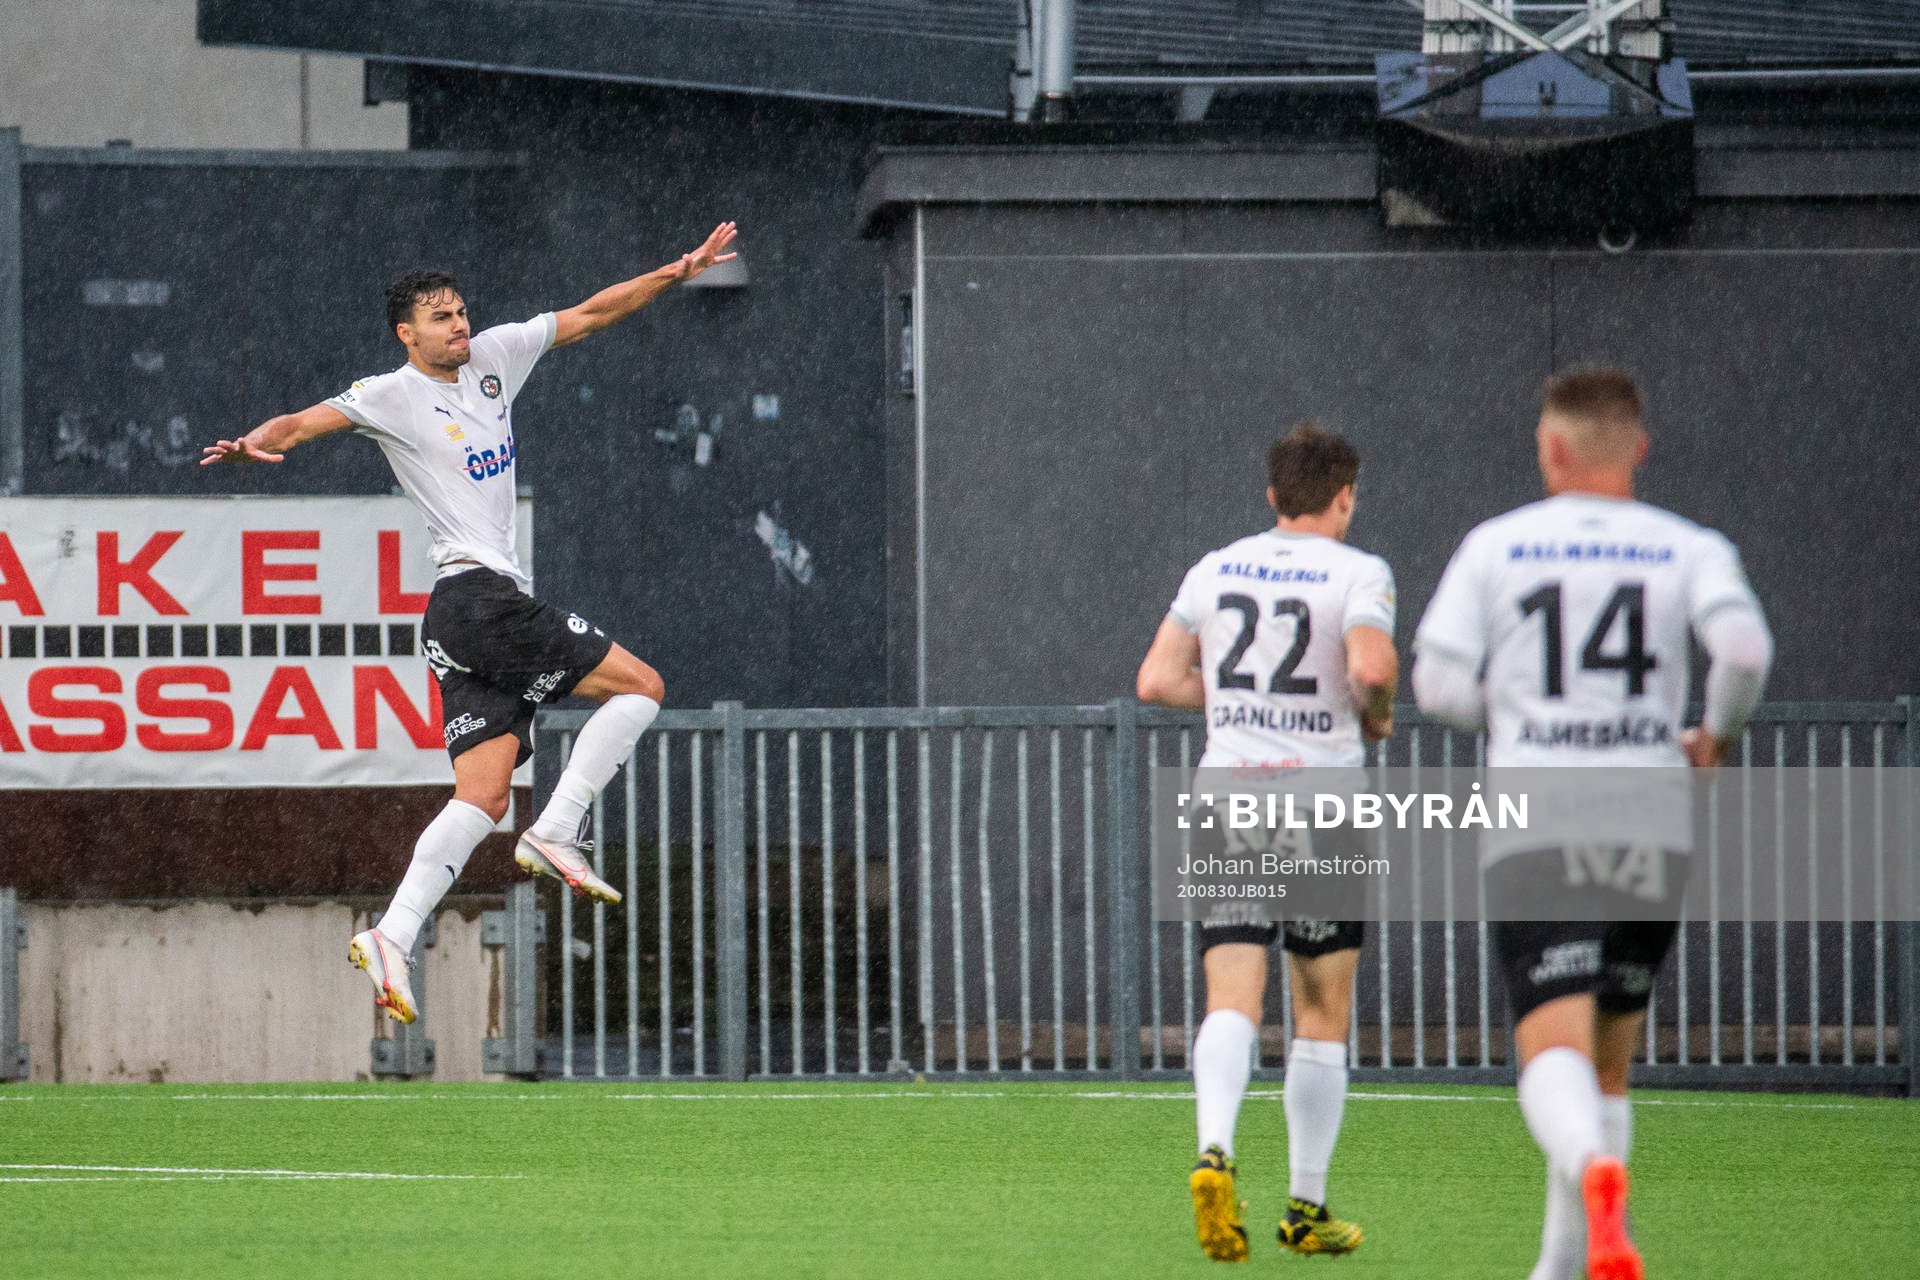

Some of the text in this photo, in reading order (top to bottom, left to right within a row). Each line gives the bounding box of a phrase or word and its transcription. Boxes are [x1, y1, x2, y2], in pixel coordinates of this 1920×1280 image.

[1216, 592, 1318, 695] 22
[1520, 581, 1658, 698] 14
[0, 665, 444, 753] SSAN
[444, 712, 473, 738] ORDIC
[445, 717, 487, 748] ELLNESS
